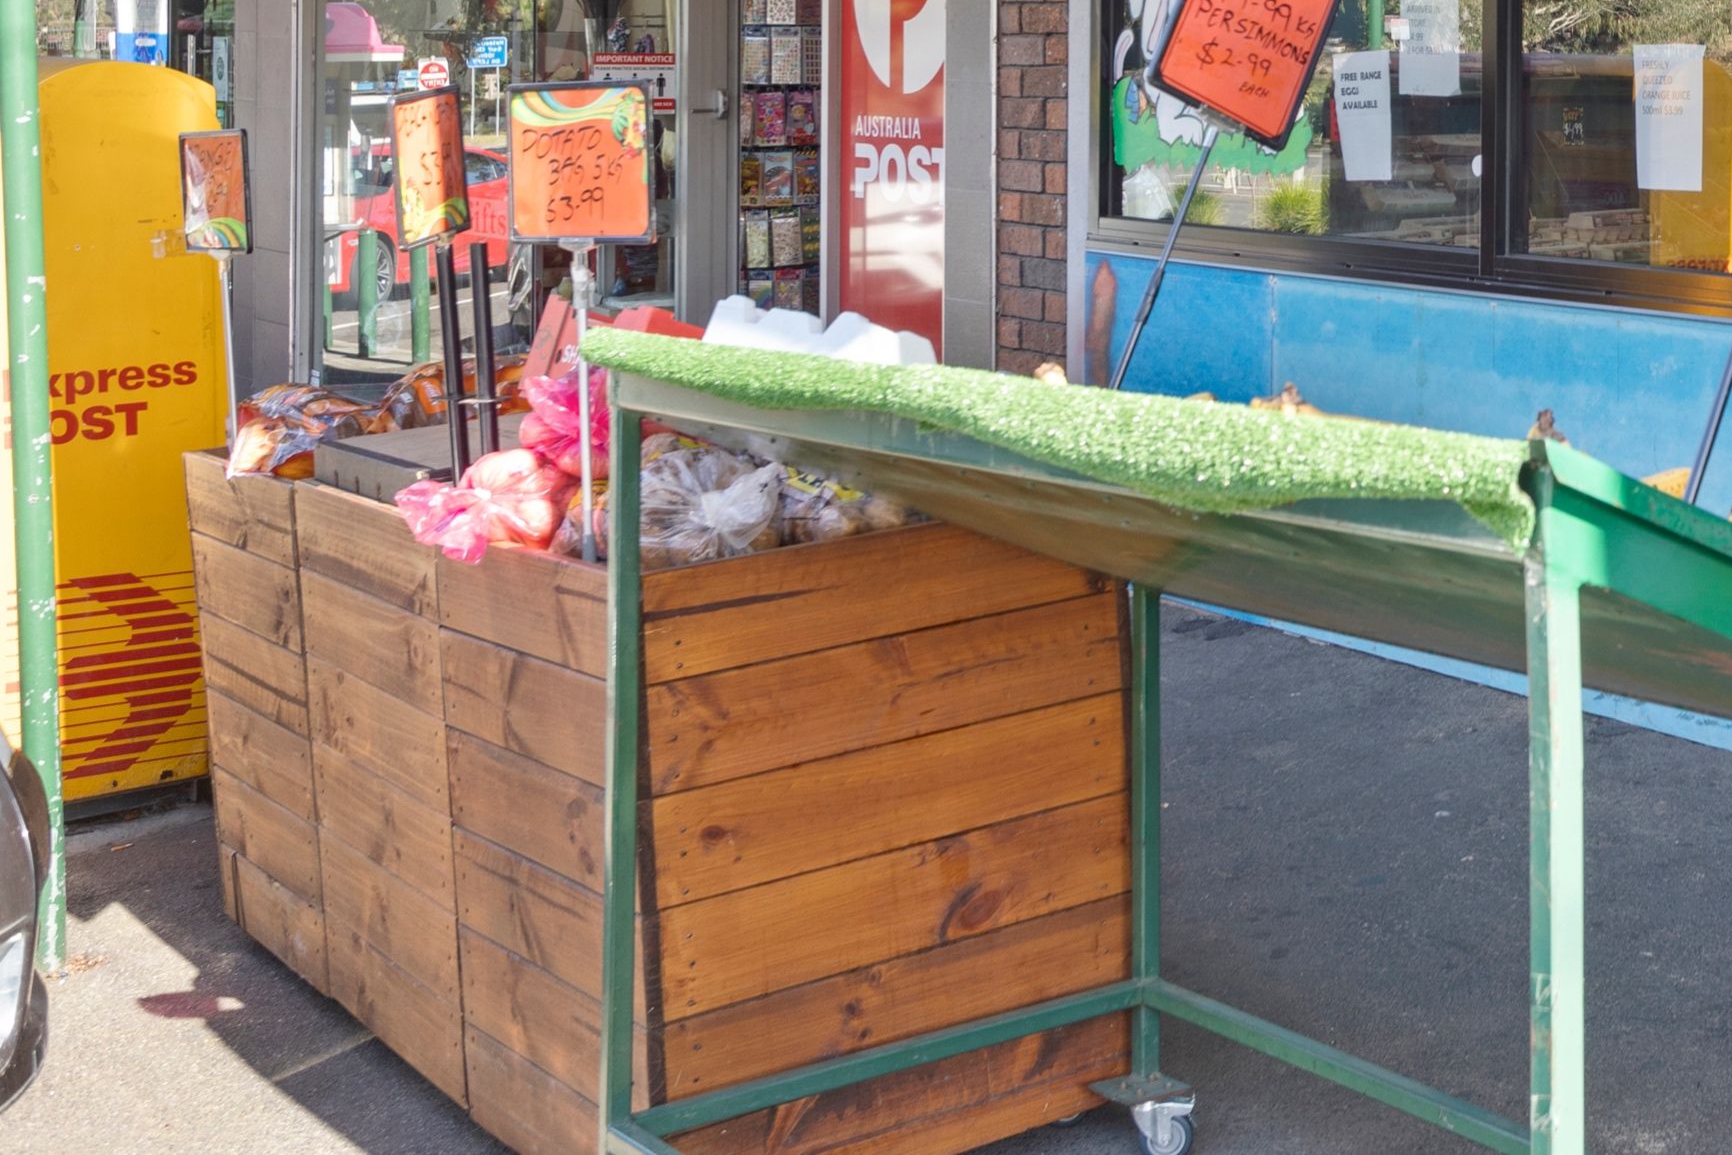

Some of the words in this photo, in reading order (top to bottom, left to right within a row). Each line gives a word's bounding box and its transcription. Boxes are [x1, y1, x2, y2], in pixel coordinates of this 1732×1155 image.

[596, 54, 643, 63] IMPORTANT
[644, 55, 674, 63] NOTICE
[1642, 60, 1670, 69] FRESHLY
[1340, 72, 1358, 82] FREE
[1360, 70, 1382, 81] RANGE
[1238, 80, 1270, 98] EACH
[1343, 99, 1378, 110] AVAILABLE
[855, 115, 921, 139] AUSTRALIA
[522, 126, 602, 159] POTATO
[471, 200, 506, 236] ifts
